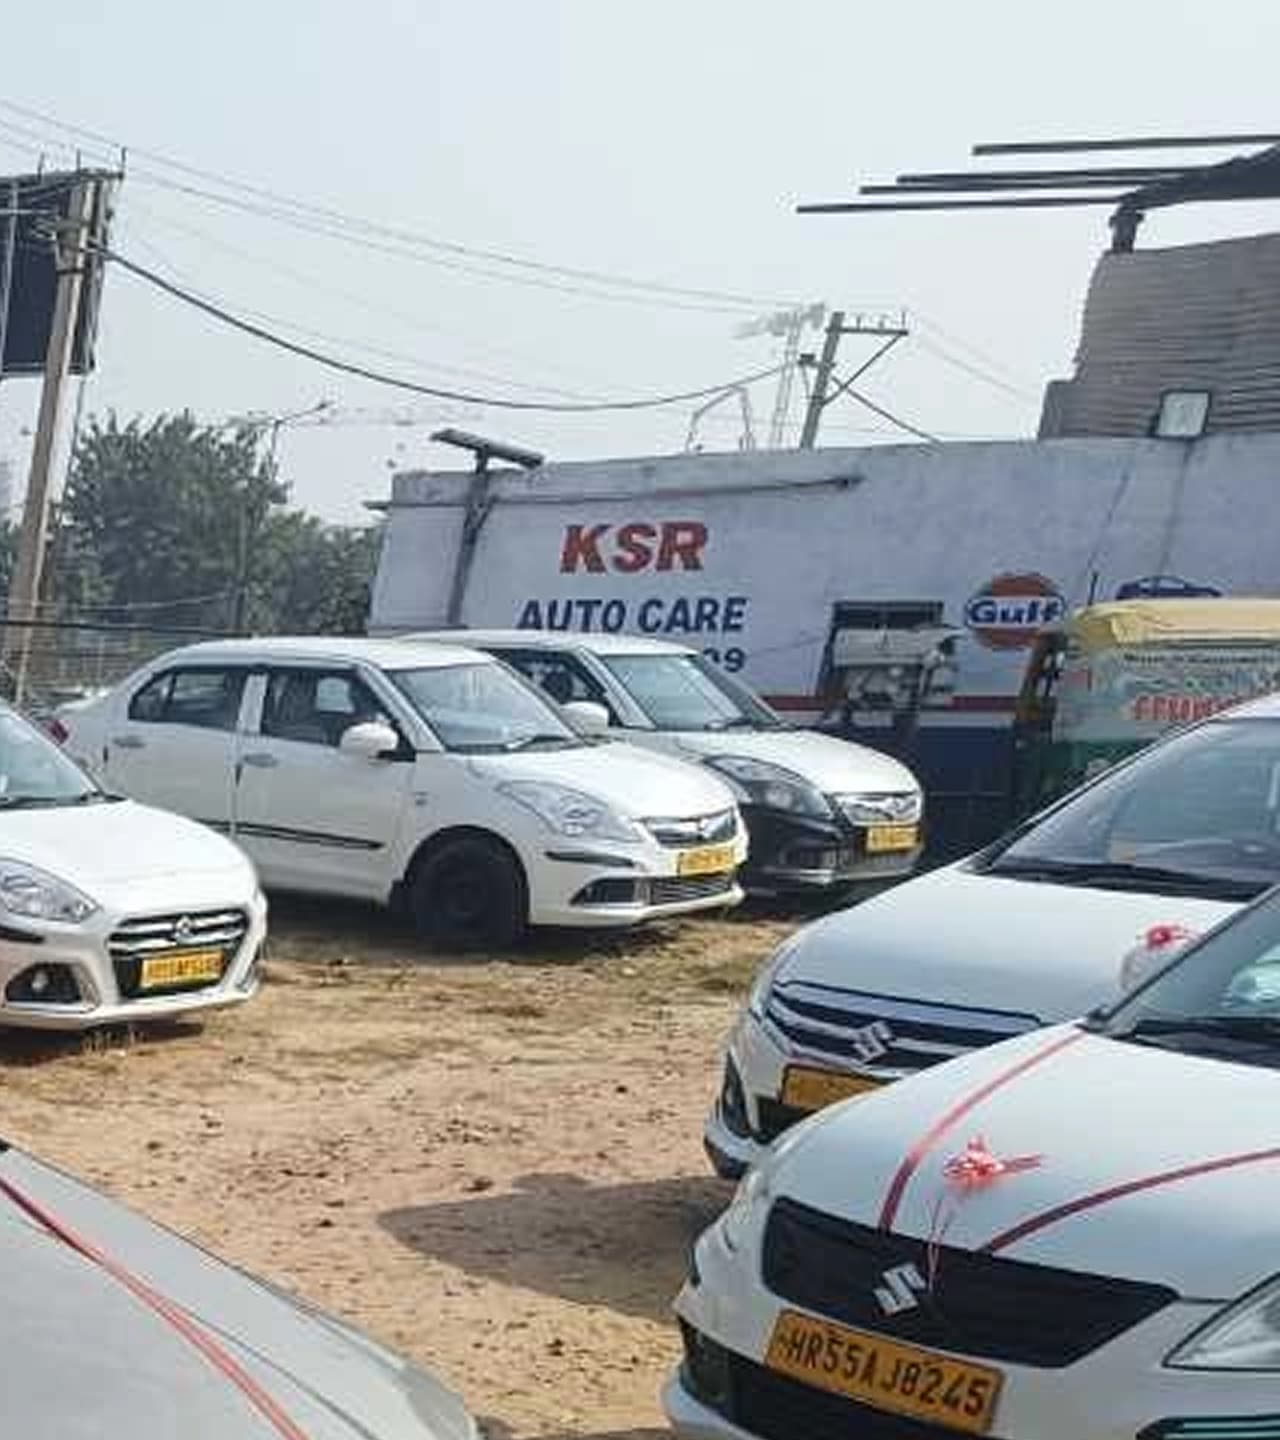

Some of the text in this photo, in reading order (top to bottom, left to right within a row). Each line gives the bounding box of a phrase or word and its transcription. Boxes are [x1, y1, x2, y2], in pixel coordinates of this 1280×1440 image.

[559, 521, 708, 574] KSR
[516, 597, 748, 633] AUTO CARE
[970, 599, 1059, 625] Gulf
